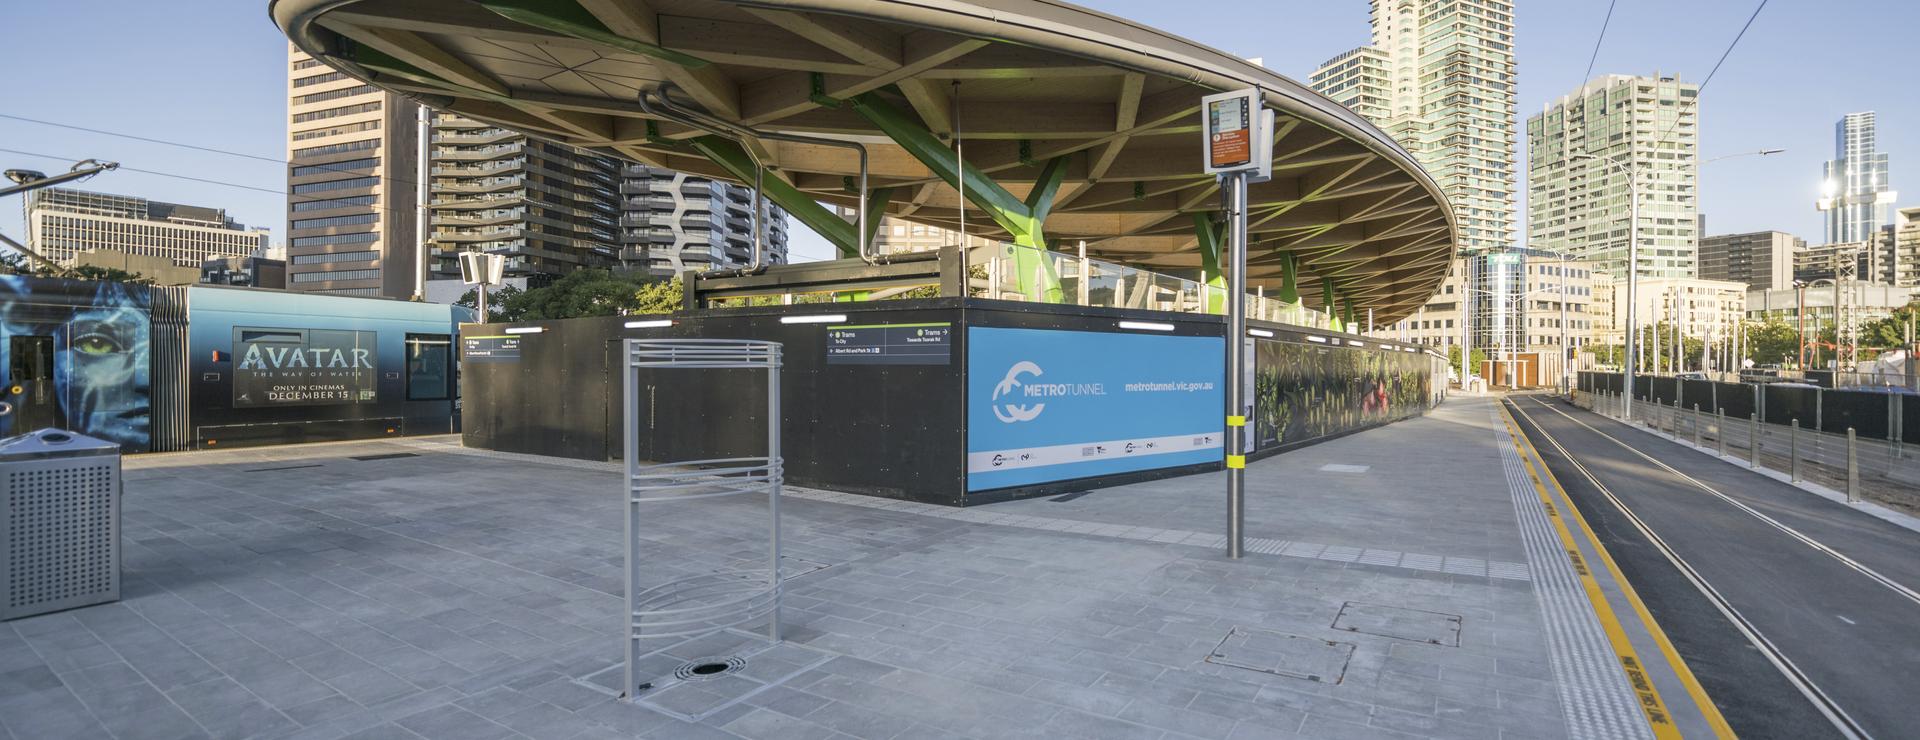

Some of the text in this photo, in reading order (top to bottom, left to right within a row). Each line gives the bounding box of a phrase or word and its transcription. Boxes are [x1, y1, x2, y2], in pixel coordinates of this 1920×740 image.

[238, 343, 374, 369] AVATAR
[1125, 381, 1214, 392] metrotunnel.vic.gov.au
[268, 391, 334, 401] DECEMBER
[338, 390, 349, 399] 15
